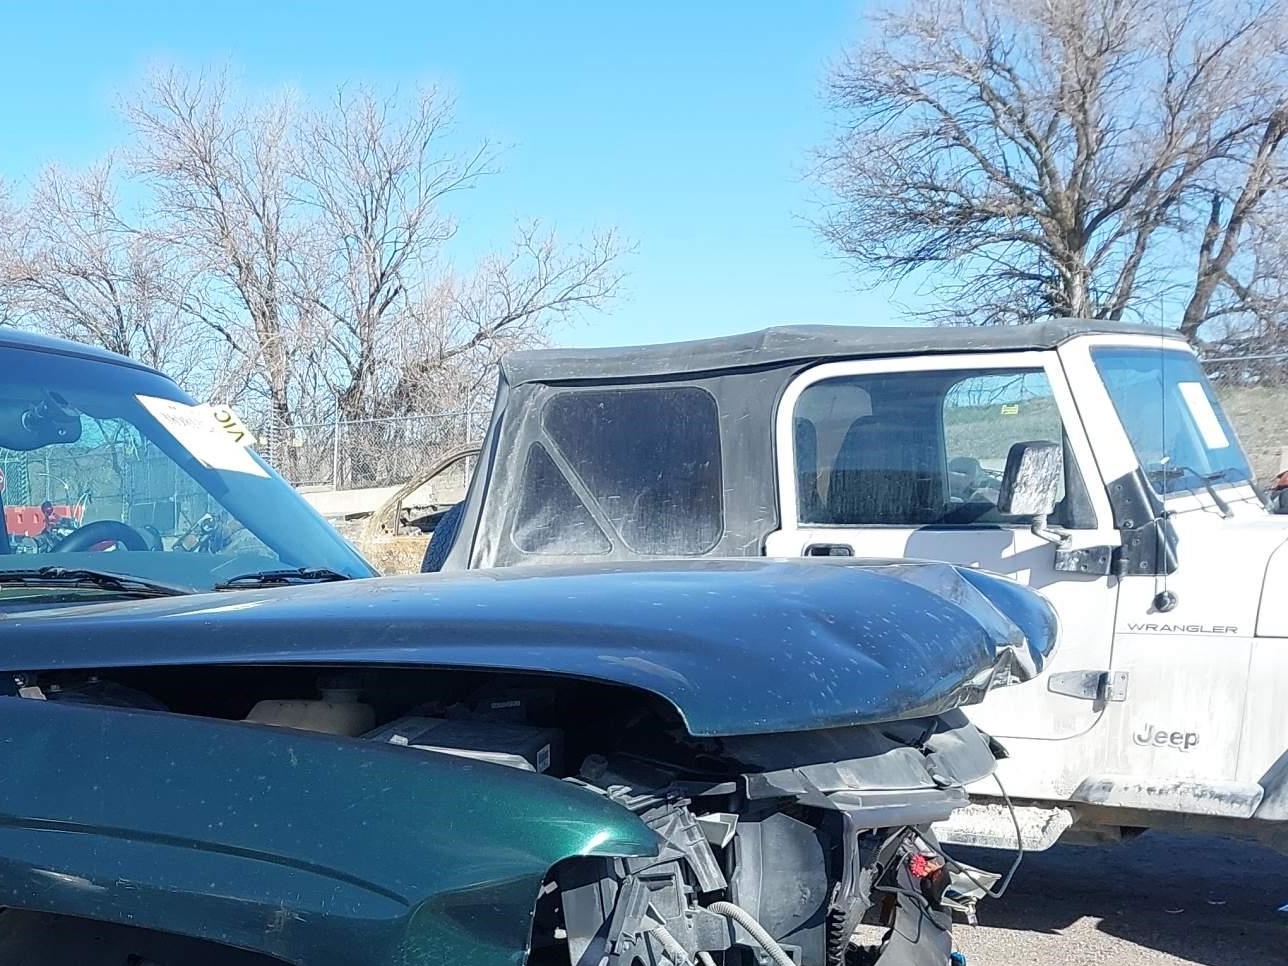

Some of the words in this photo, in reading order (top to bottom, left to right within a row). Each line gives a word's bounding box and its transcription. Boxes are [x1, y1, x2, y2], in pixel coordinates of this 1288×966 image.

[214, 410, 244, 442] VIC
[1127, 623, 1238, 634] WRANGLER
[1134, 723, 1200, 751] Jeep
